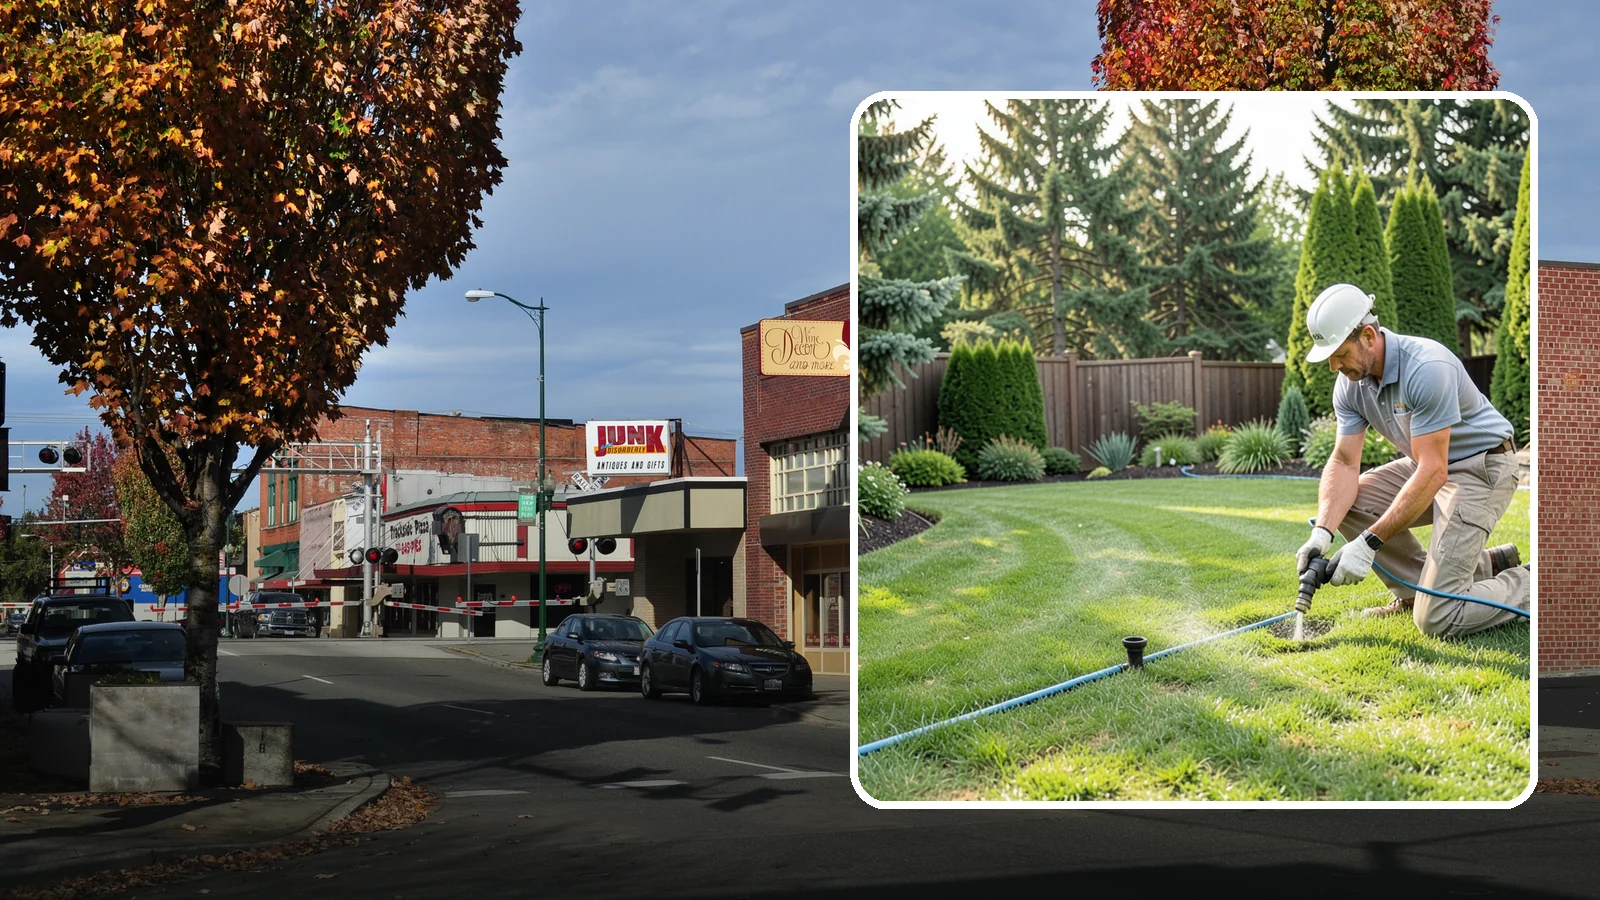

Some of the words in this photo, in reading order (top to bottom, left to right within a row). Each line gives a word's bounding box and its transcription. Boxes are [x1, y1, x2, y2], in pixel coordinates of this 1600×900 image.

[595, 425, 664, 457] JUNK
[607, 446, 646, 454] DISORDERLY
[597, 461, 628, 470] ANTIQUES
[631, 461, 644, 470] AND
[647, 460, 665, 469] GIFTS
